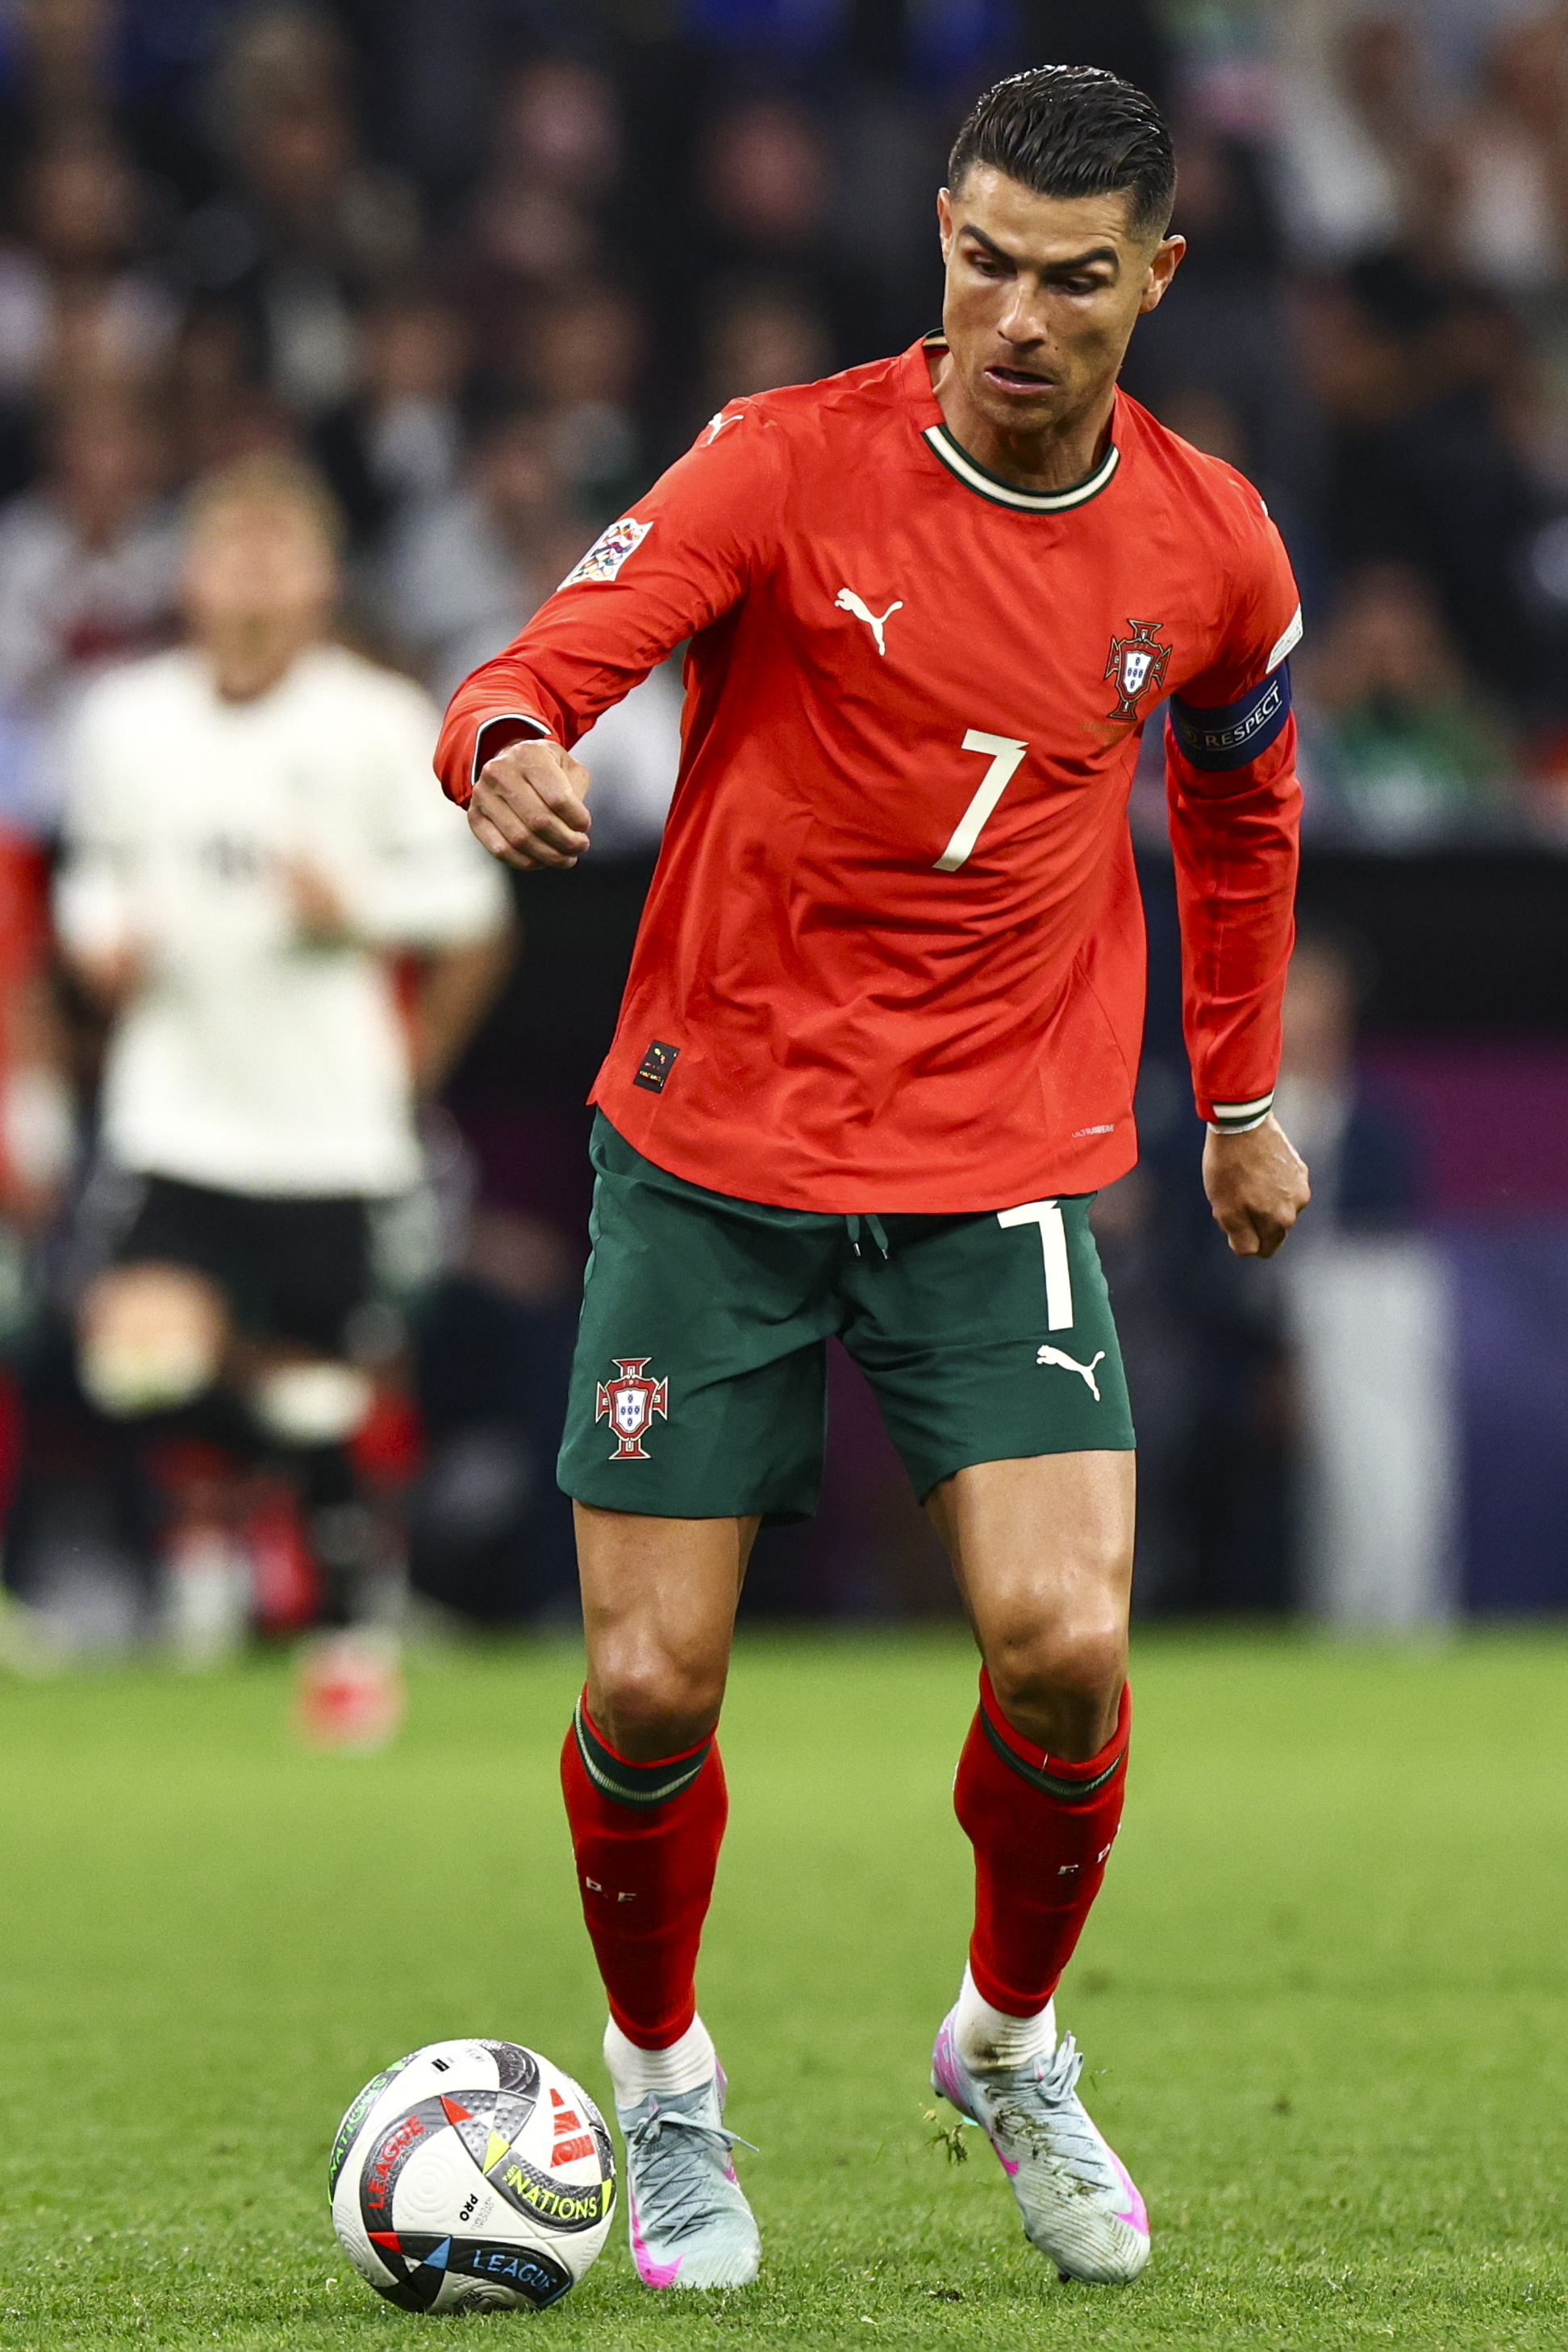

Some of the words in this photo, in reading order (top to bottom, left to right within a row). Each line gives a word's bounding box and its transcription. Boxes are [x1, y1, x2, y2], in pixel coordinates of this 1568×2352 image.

[1205, 685, 1281, 747] RESPECT
[932, 728, 1030, 872] 7
[996, 1200, 1074, 1331] 7
[367, 2114, 426, 2208] LEAGUE
[507, 2169, 597, 2220] NATIONS
[460, 2193, 478, 2221] PRO
